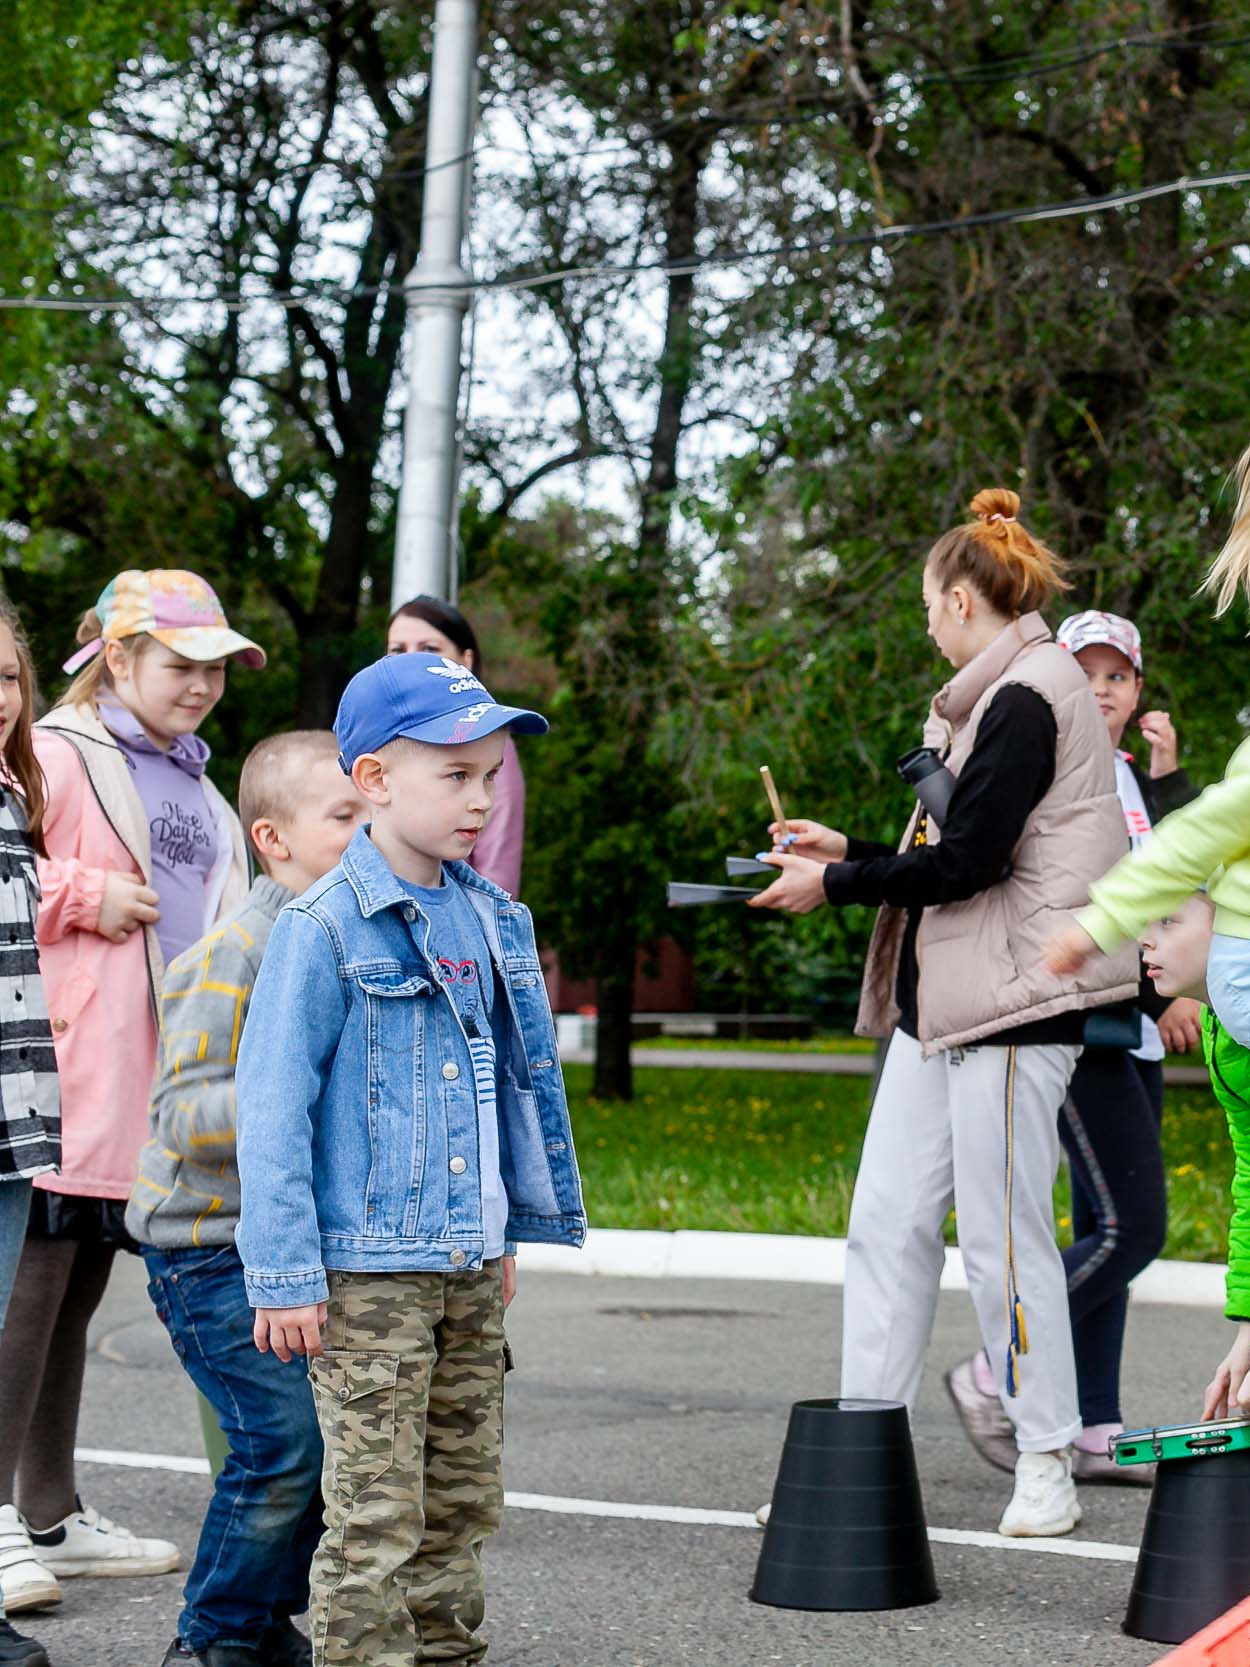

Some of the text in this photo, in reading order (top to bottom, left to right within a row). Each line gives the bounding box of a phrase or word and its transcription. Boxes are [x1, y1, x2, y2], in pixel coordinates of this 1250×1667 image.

[161, 800, 203, 830] Nice
[149, 816, 211, 848] Day for
[160, 841, 196, 869] You
